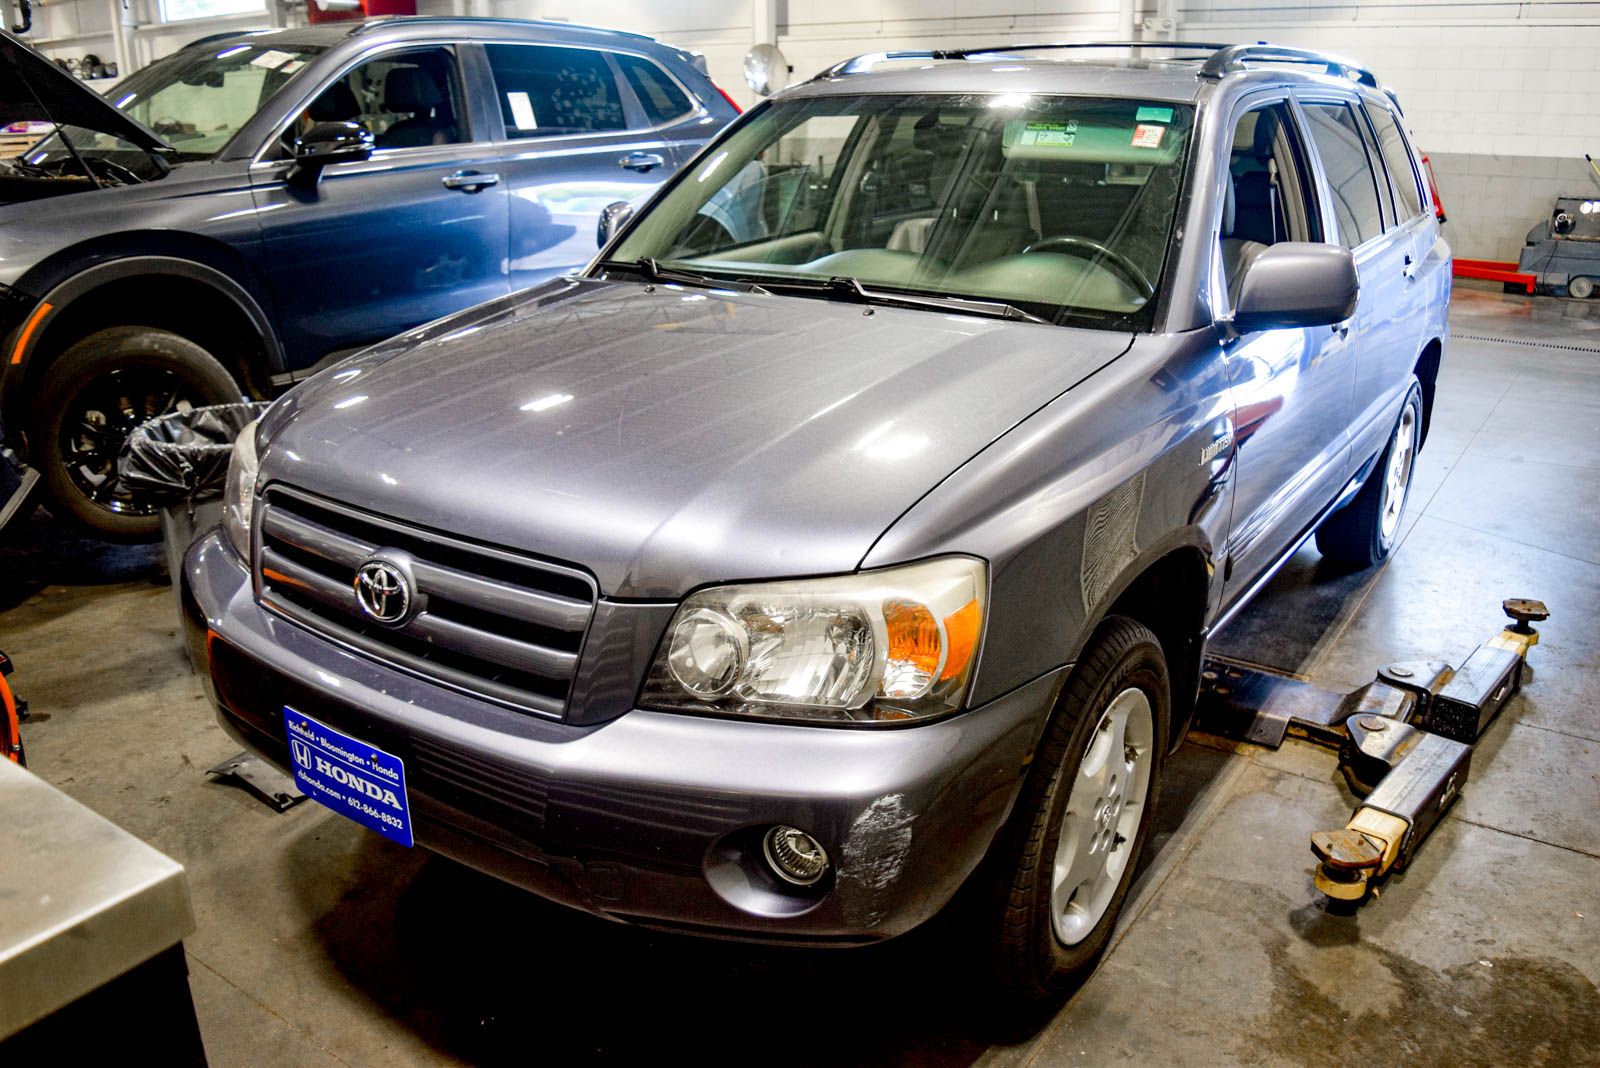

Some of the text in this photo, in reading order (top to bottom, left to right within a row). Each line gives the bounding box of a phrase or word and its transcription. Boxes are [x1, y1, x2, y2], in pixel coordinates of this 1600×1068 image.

[315, 756, 404, 811] HONDA
[320, 736, 365, 765] Bloomington
[372, 761, 399, 780] Honda
[298, 769, 404, 830] rbhonda.com 612-866-8832
